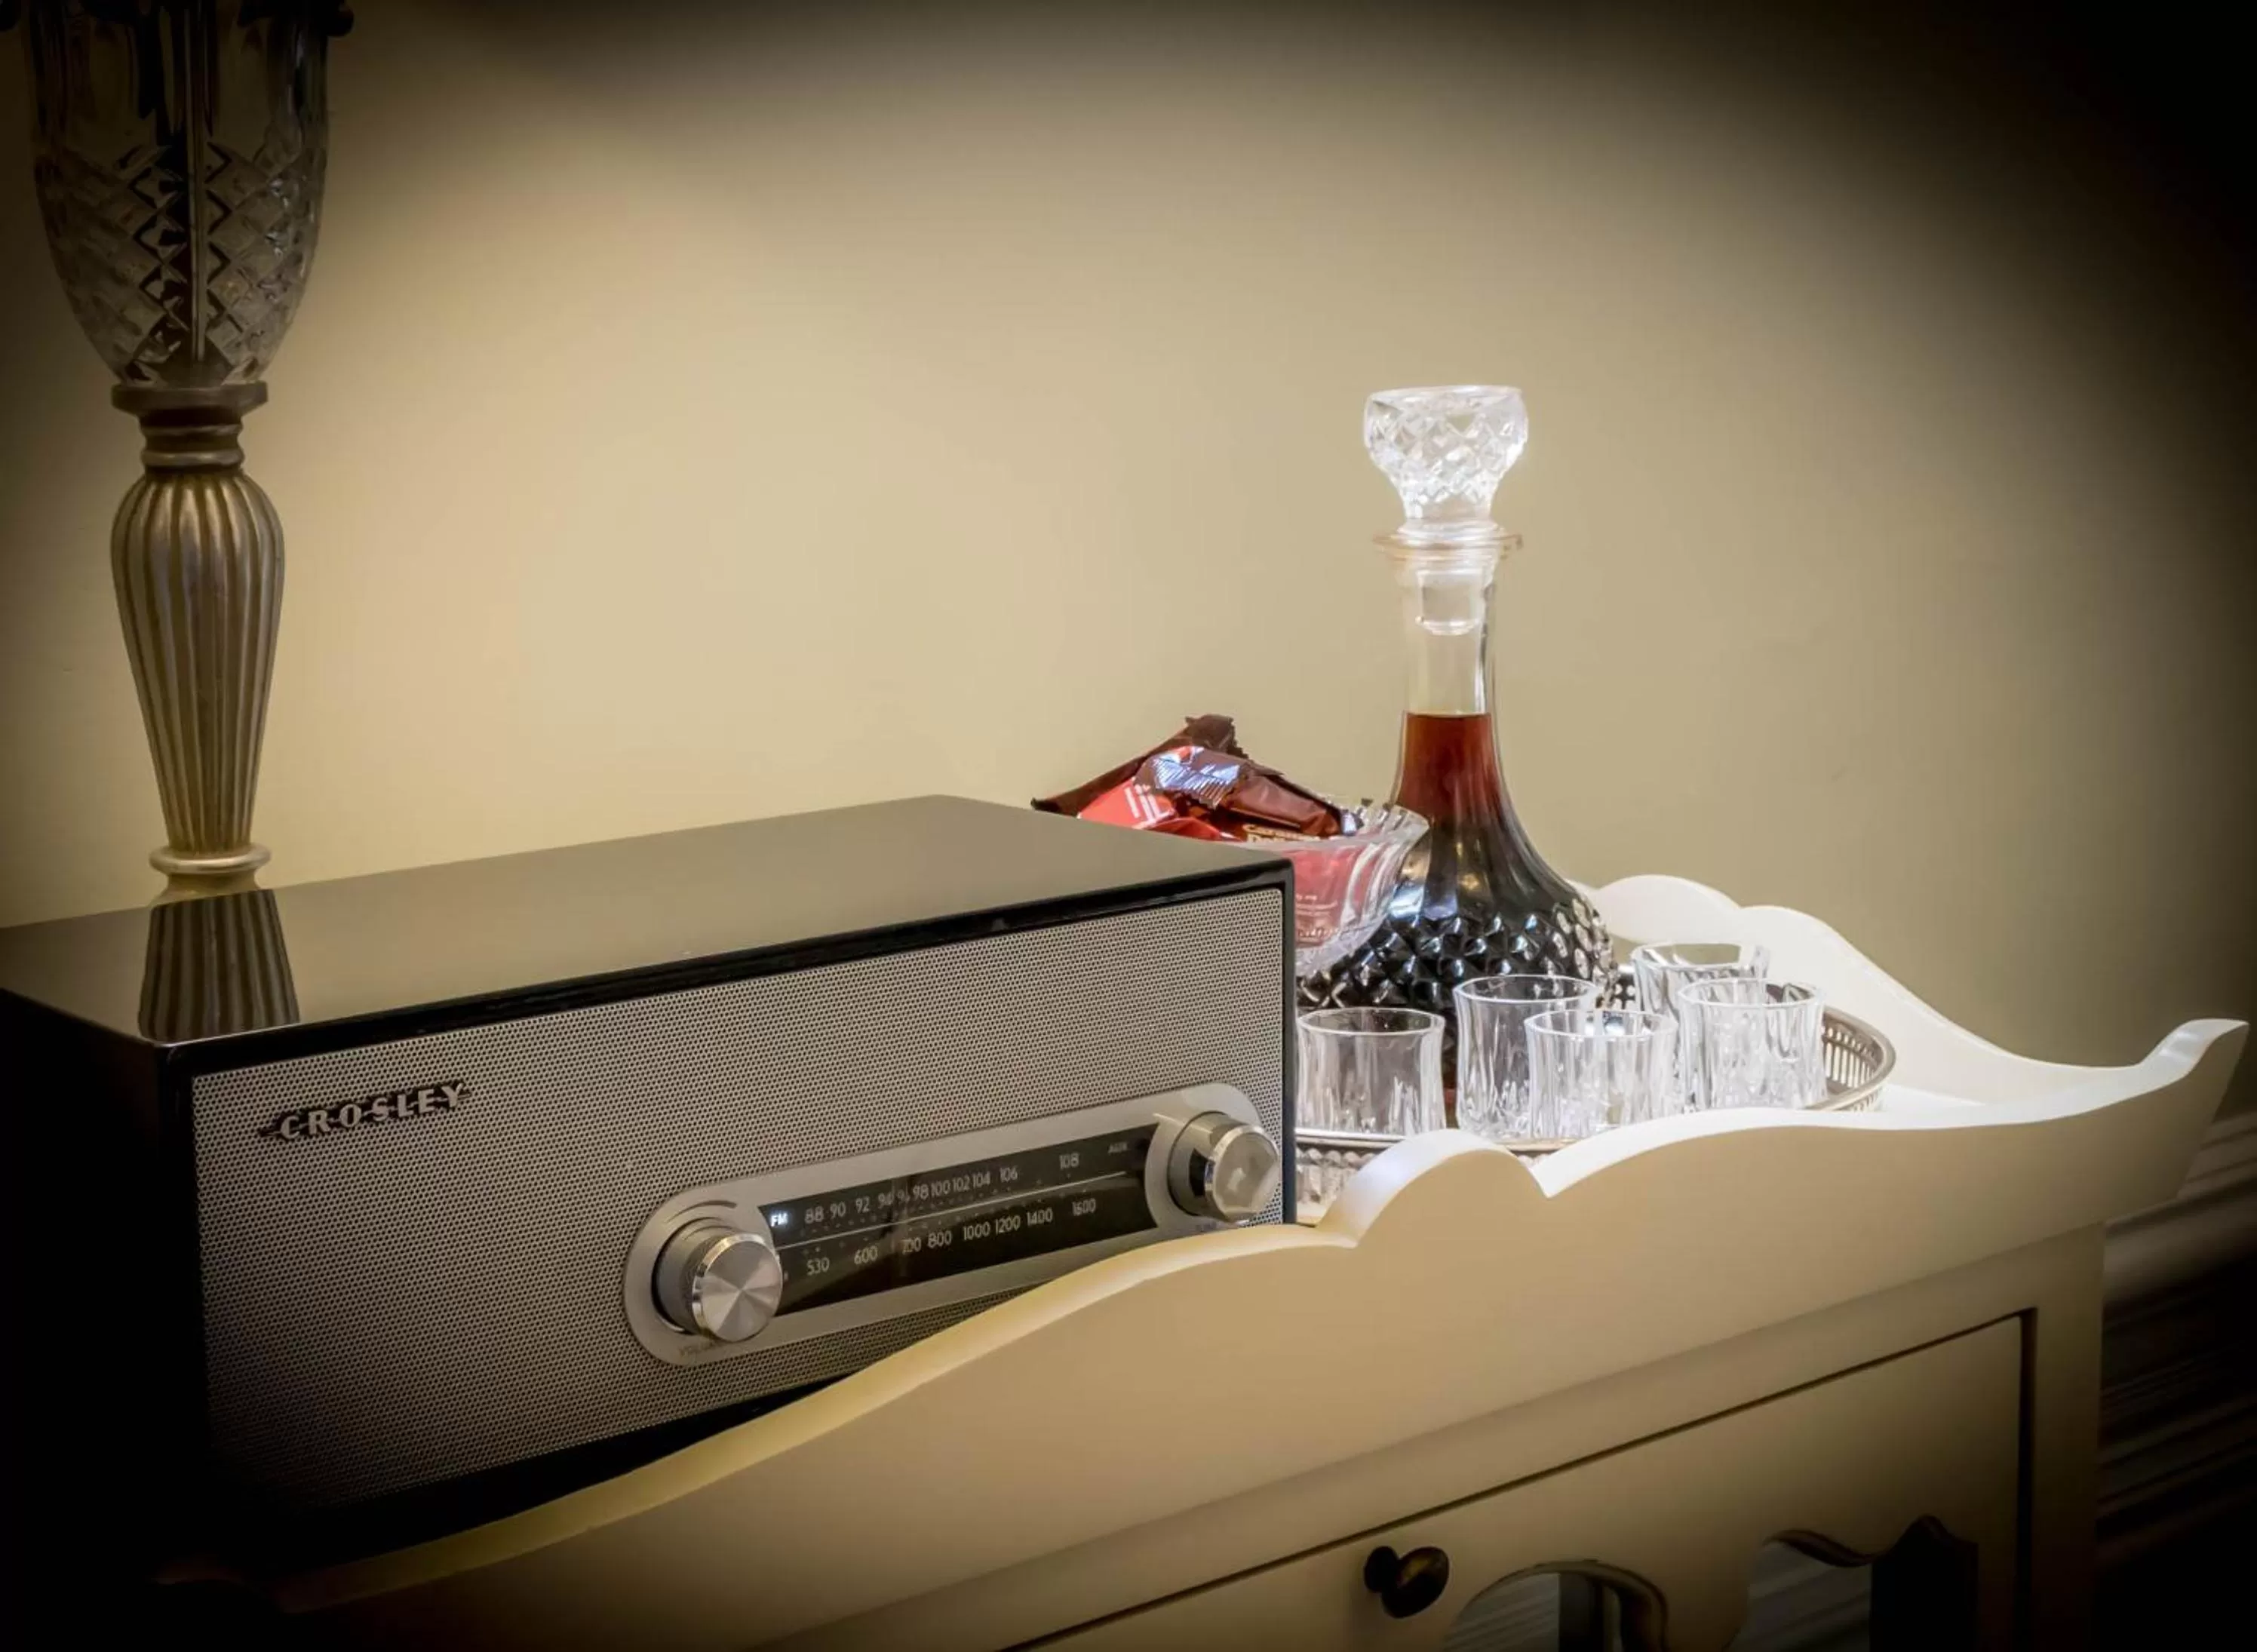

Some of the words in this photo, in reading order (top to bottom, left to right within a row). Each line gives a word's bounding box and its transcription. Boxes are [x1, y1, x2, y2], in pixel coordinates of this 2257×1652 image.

[279, 1082, 465, 1139] CROSLEY
[771, 1211, 788, 1227] FM
[805, 1206, 824, 1224] 88
[831, 1201, 846, 1219] 90
[855, 1196, 870, 1213] 92
[913, 1184, 929, 1201] 98
[931, 1180, 950, 1196] 100
[952, 1175, 969, 1192] 102
[972, 1171, 990, 1188] 104
[1000, 1165, 1018, 1183] 106
[1059, 1152, 1079, 1169] 108
[806, 1257, 830, 1276] 530
[854, 1245, 878, 1265] 600
[928, 1230, 952, 1248] 800
[963, 1221, 990, 1241] 1000
[996, 1215, 1021, 1234] 1200
[1026, 1208, 1053, 1227] 1400
[1072, 1198, 1096, 1217] 1600
